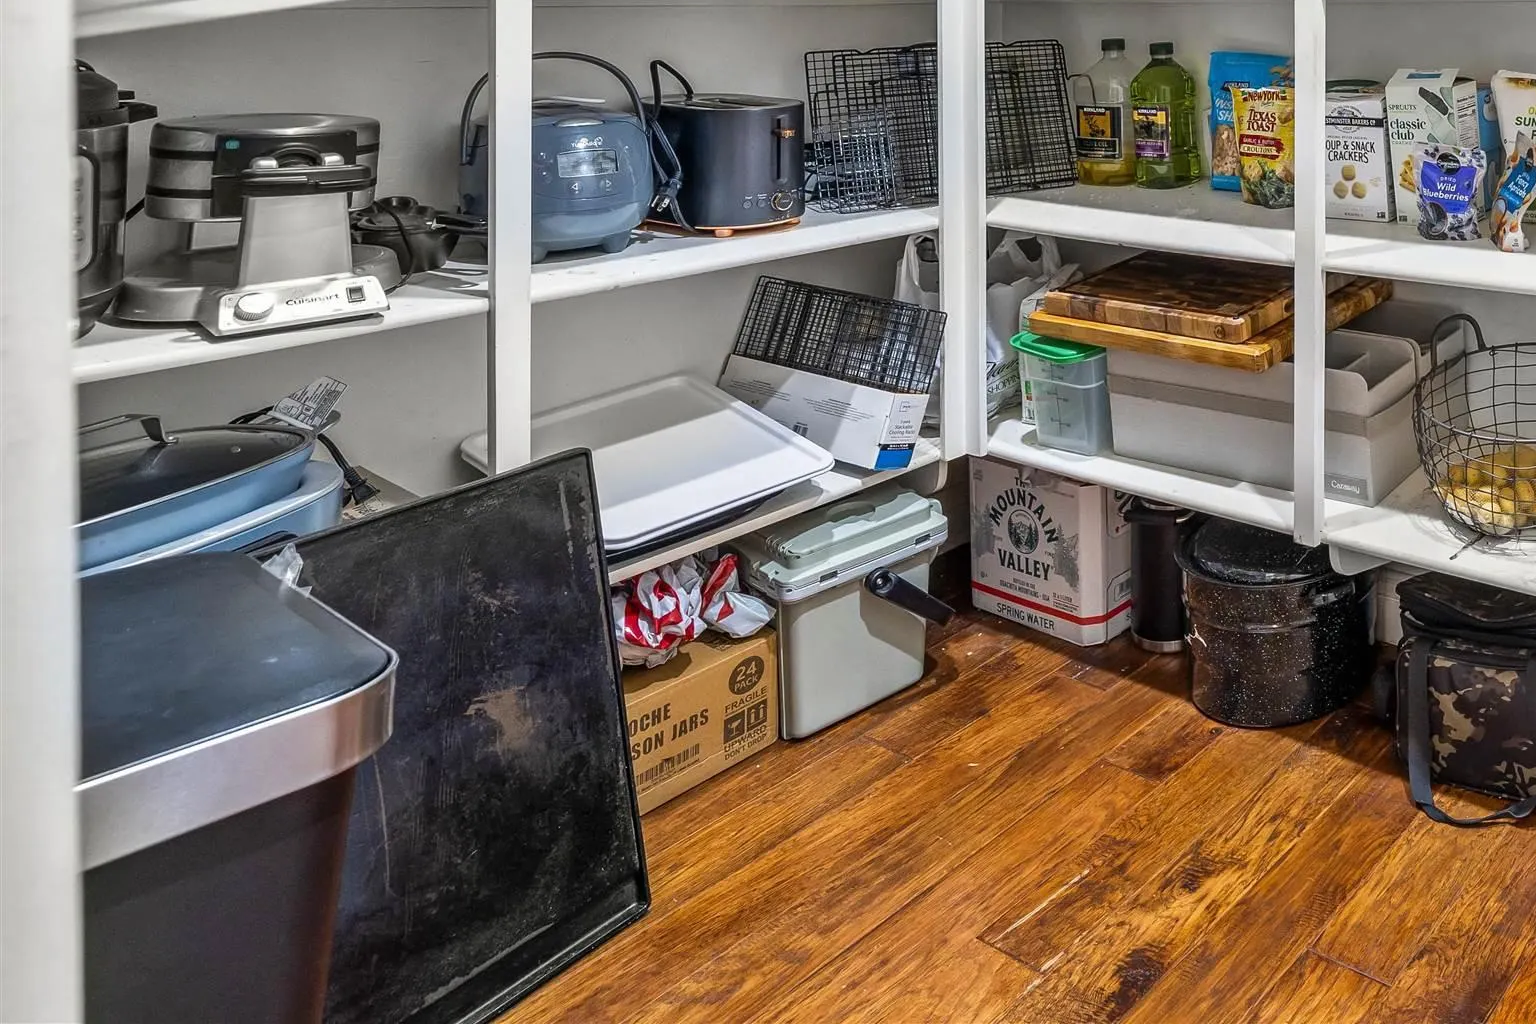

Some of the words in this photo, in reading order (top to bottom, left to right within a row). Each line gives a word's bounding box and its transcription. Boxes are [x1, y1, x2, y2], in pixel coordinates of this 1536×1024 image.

[1249, 109, 1277, 122] TEXAS
[1247, 120, 1277, 132] TOAST
[1390, 118, 1427, 130] classic
[1391, 129, 1415, 141] club
[1243, 145, 1273, 154] CROUTONS
[1325, 140, 1341, 151] OUP
[1343, 141, 1349, 151] &
[1351, 141, 1376, 153] SNACK
[1328, 150, 1369, 164] CRACKERS
[1422, 187, 1469, 202] Blueberries
[1437, 182, 1457, 192] Wild
[286, 293, 339, 306] Cuisinart
[987, 374, 1020, 394] SHOPPIN
[1331, 480, 1360, 494] Caraway
[989, 488, 1059, 544] MOUNTAIN
[998, 548, 1051, 581] VALLEY
[997, 603, 1026, 622] SPRING
[1027, 611, 1055, 630] WATER
[736, 661, 758, 683] 24
[734, 676, 759, 692] PACK
[725, 686, 768, 714] FRAGILE
[629, 703, 671, 737] OCHE
[632, 730, 665, 761] SON
[671, 709, 709, 741] JARS
[724, 725, 767, 753] UPWARD
[725, 747, 746, 761] DON'T
[747, 733, 767, 749] DROP
